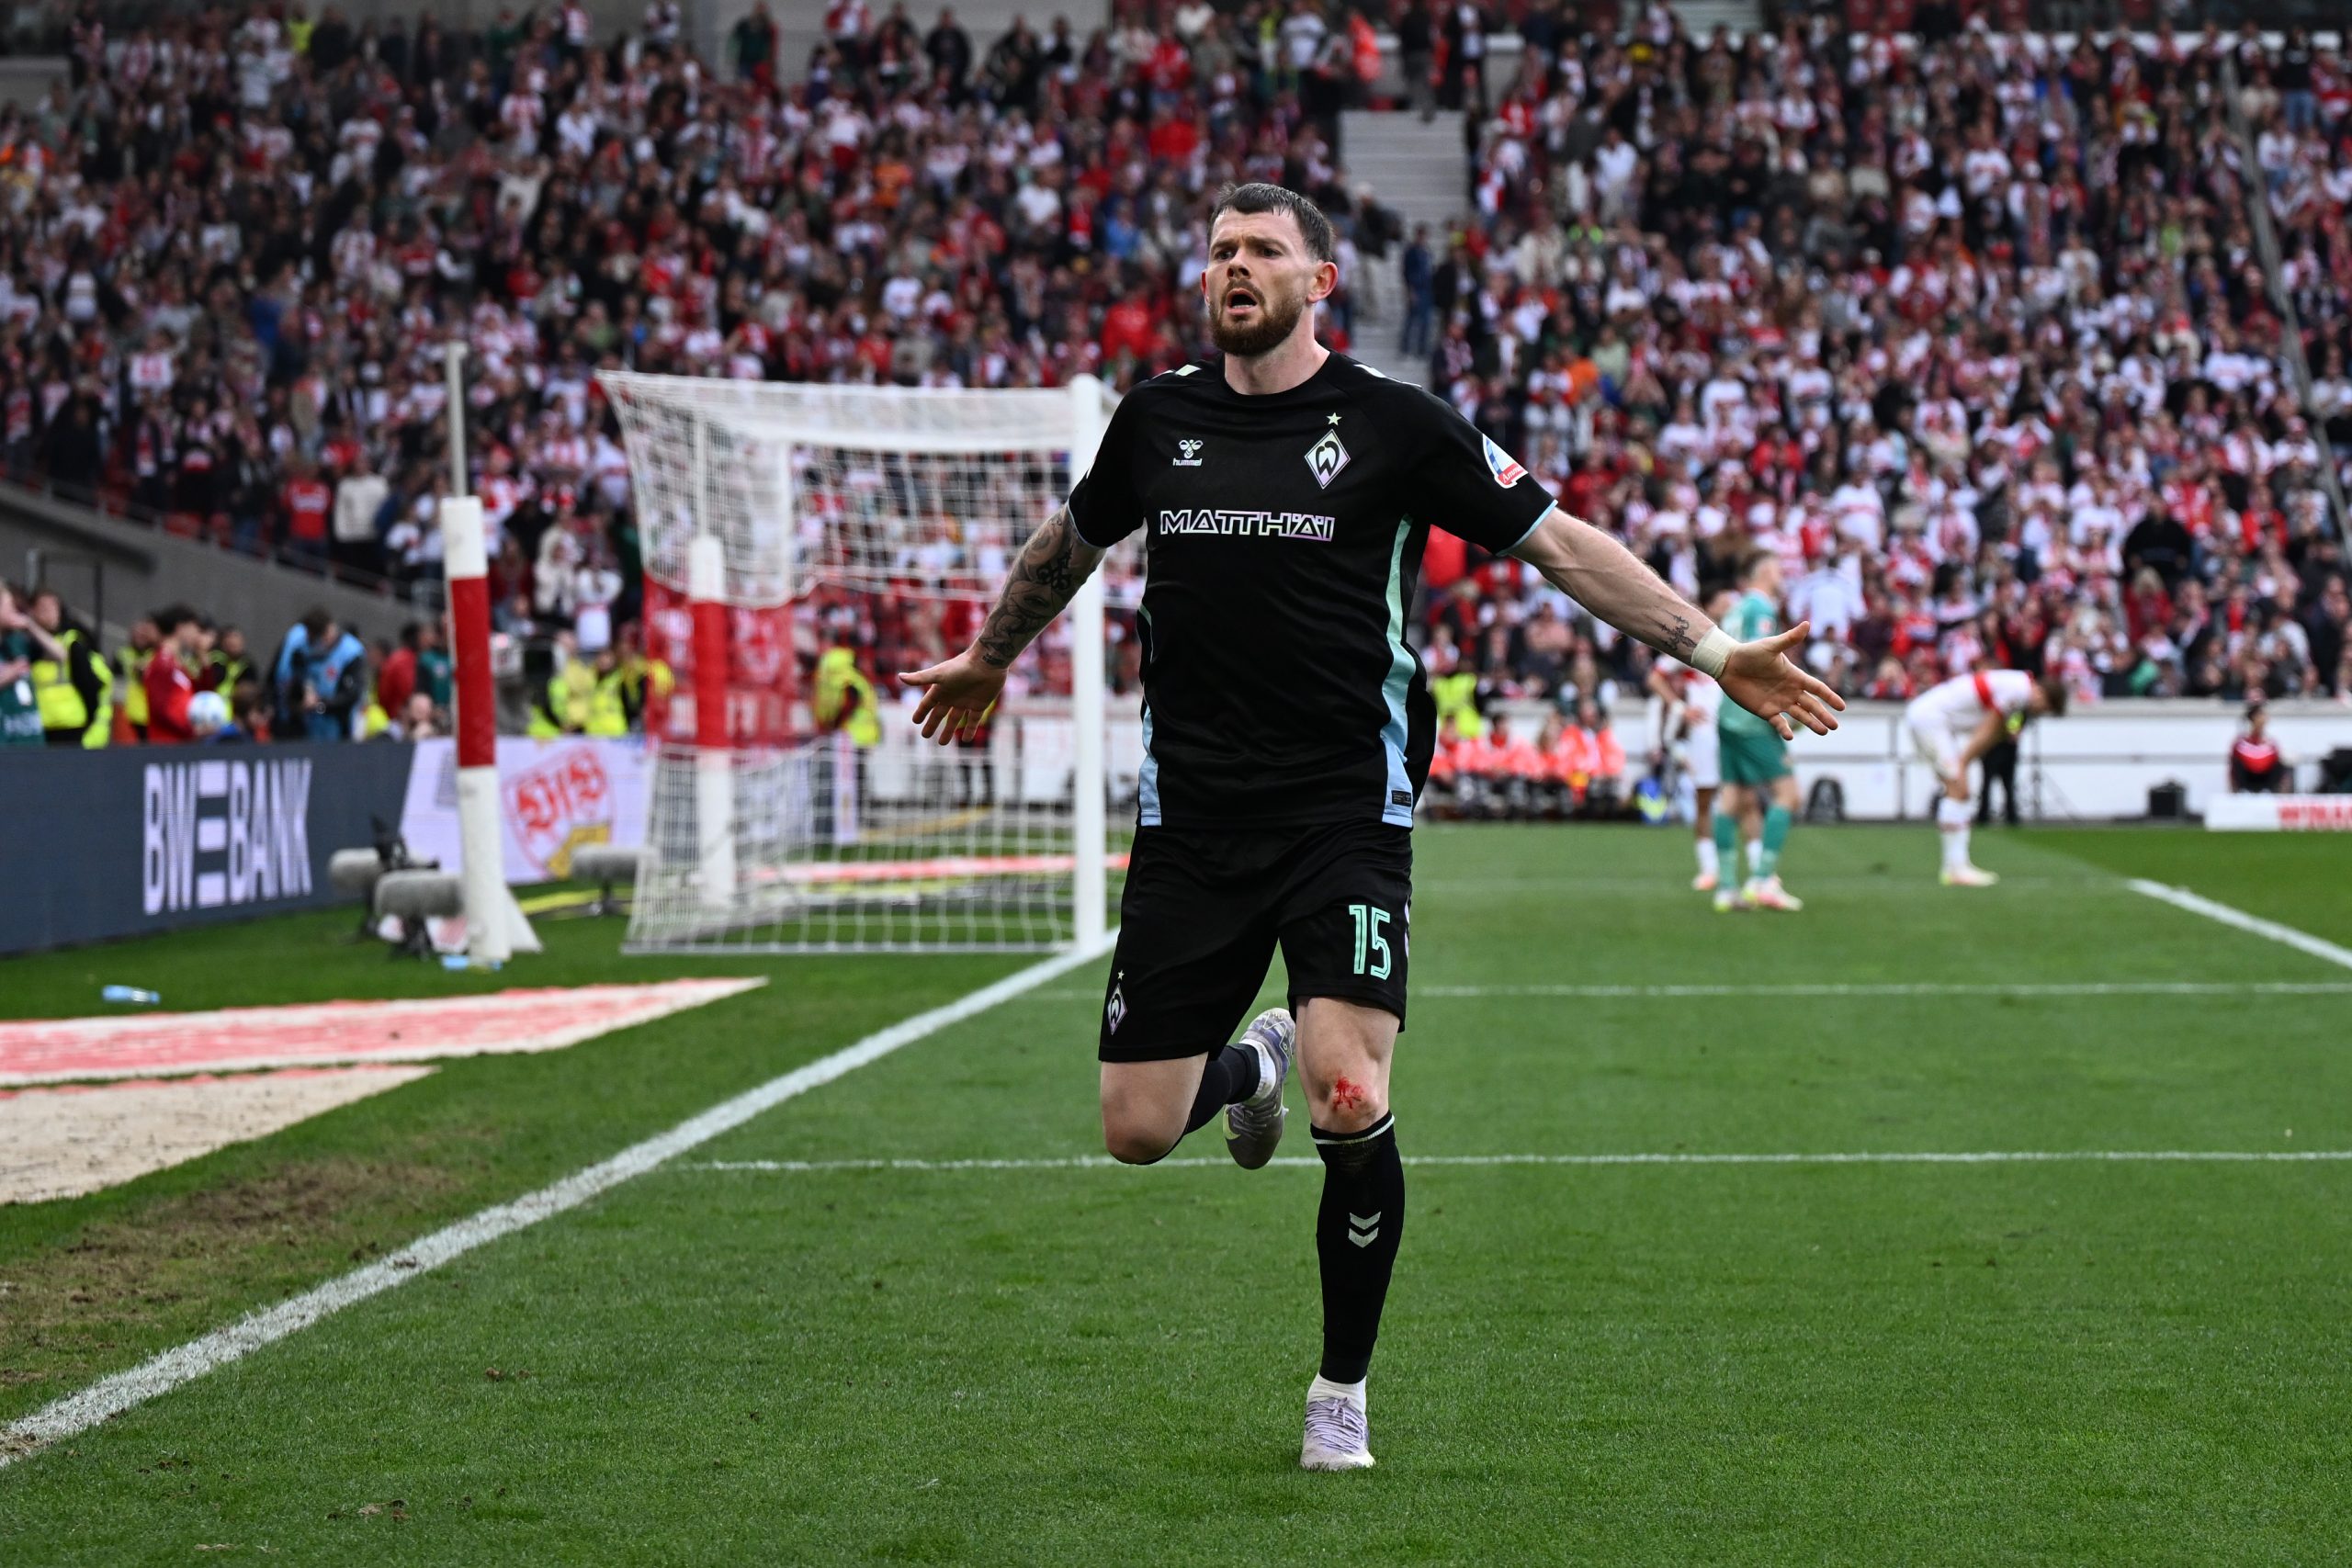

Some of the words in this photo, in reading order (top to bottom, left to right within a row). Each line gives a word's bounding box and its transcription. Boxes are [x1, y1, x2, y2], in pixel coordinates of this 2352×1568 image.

[1172, 457, 1203, 467] hummel
[1160, 509, 1335, 542] MATTHÄI
[1349, 904, 1392, 981] 15
